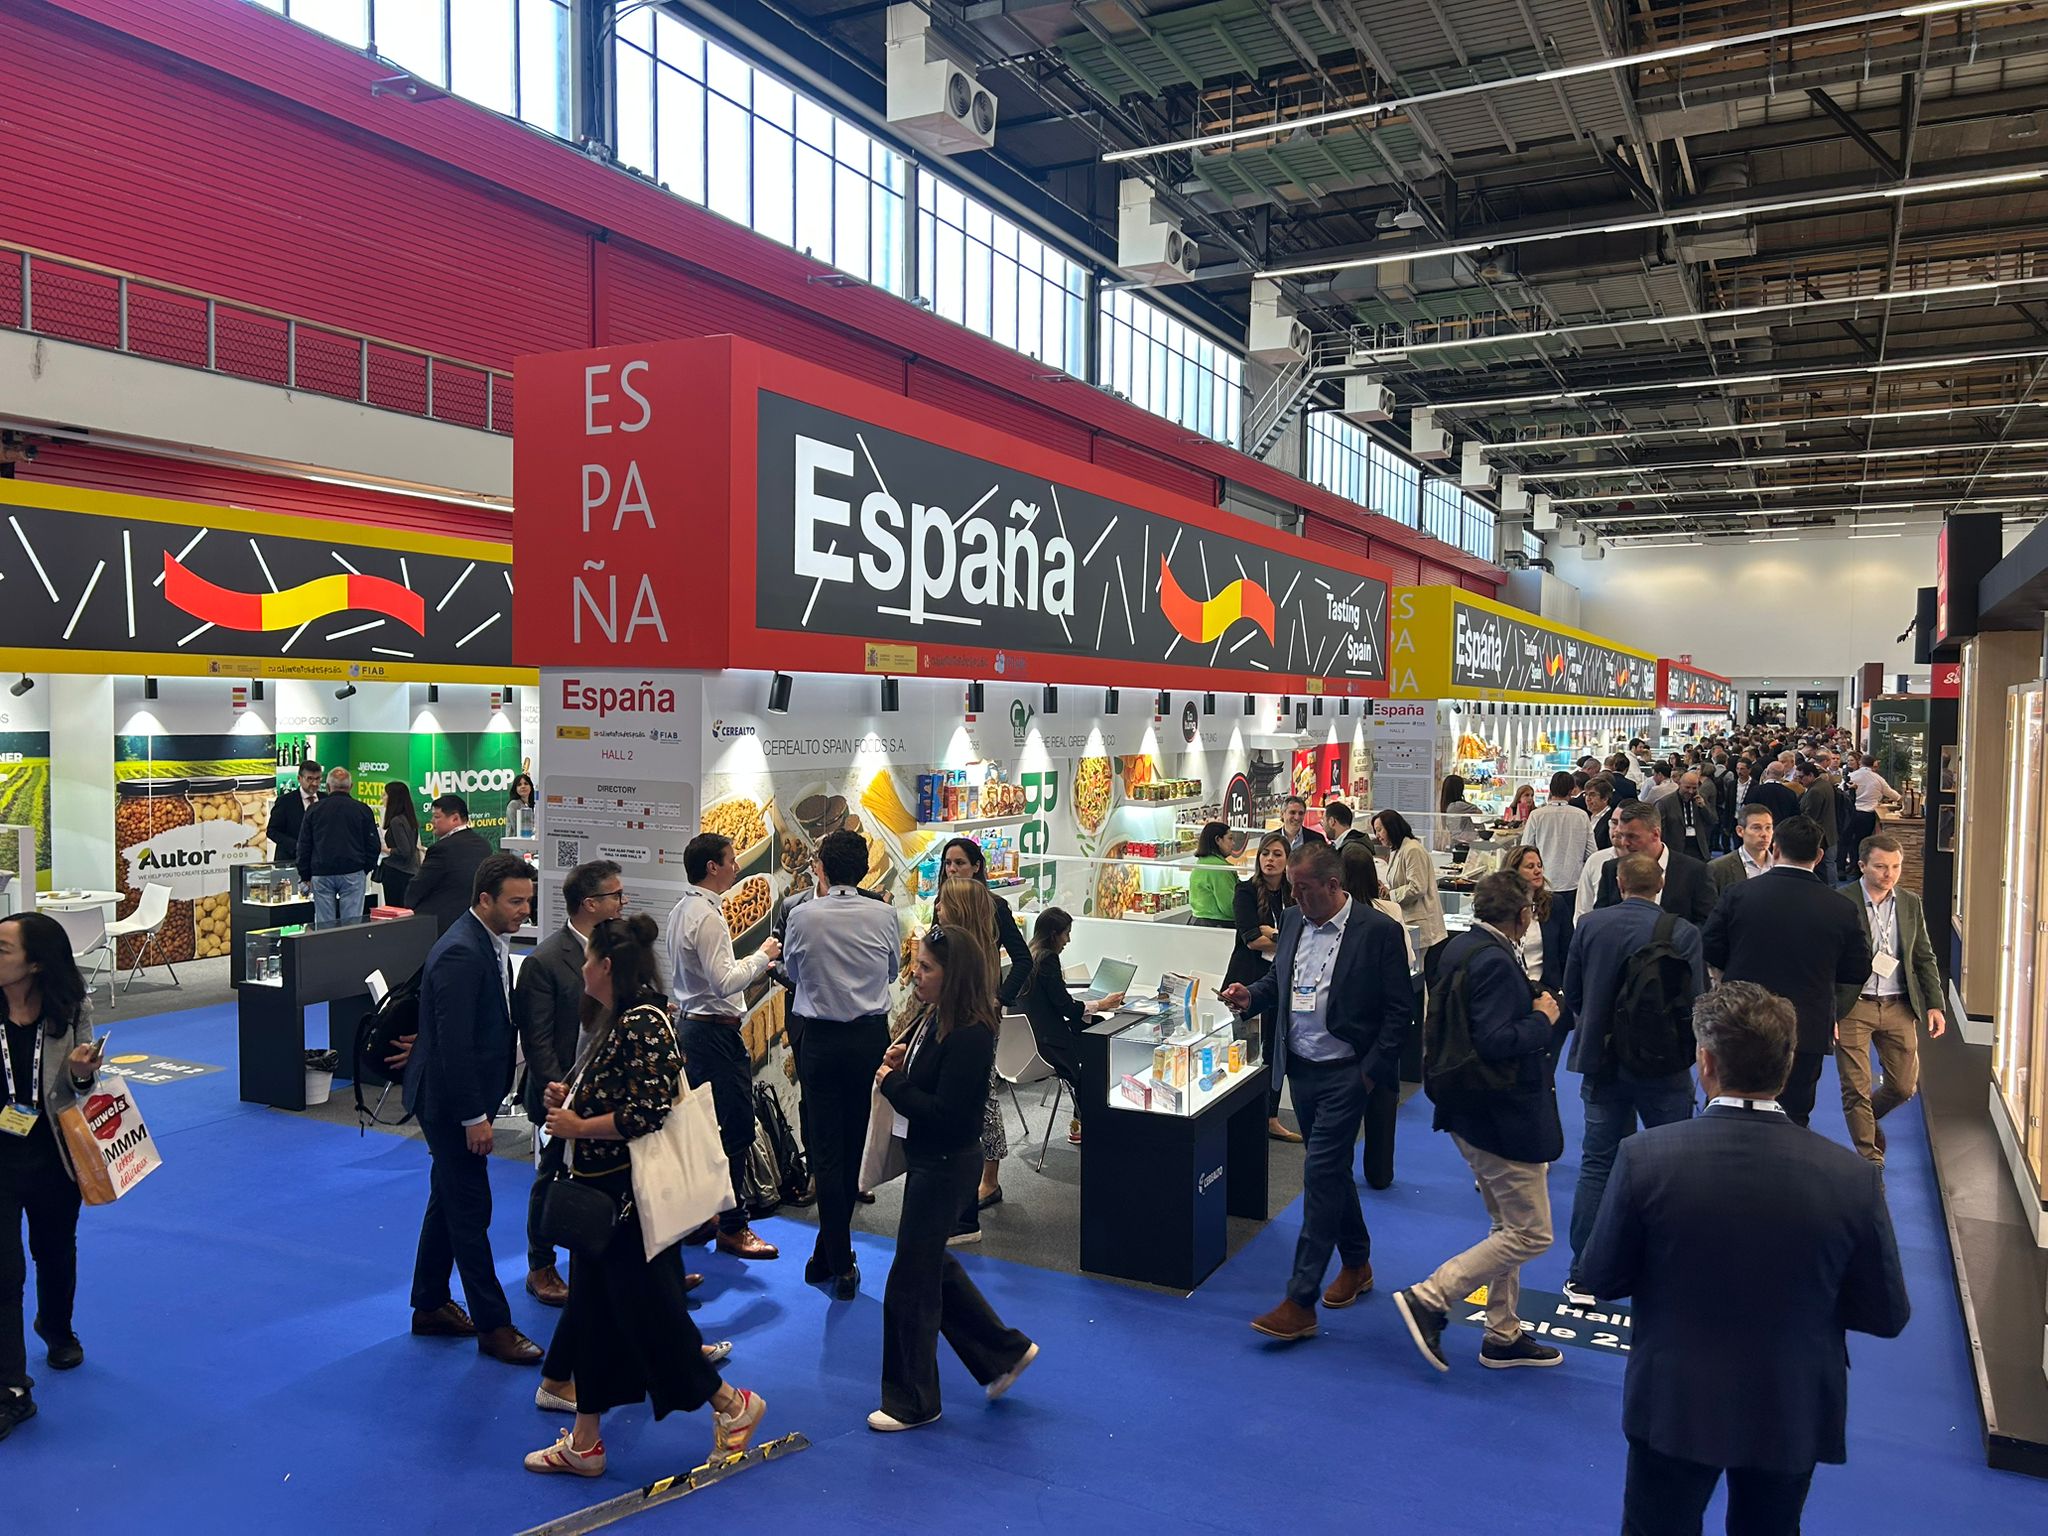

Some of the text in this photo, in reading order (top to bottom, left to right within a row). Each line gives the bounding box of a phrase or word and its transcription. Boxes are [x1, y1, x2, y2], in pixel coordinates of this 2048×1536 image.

[584, 360, 651, 435] ES
[582, 460, 656, 532] PA
[794, 433, 1075, 625] España
[573, 560, 668, 643] ÑA
[1326, 593, 1360, 630] Tasting
[1347, 634, 1372, 665] Spain
[1456, 613, 1502, 679] España
[362, 666, 385, 675] FIAB
[562, 679, 675, 718] España
[1374, 703, 1424, 718] España
[309, 716, 339, 726] GROUP
[660, 731, 678, 739] FIAB
[721, 727, 755, 736] CEREALTO
[1052, 735, 1066, 747] REAL
[601, 749, 633, 760] HALL 2
[763, 739, 820, 755] CEREALTO
[823, 738, 852, 754] SPAIN
[889, 738, 906, 752] S.A.
[358, 782, 385, 796] EXTR
[418, 768, 515, 800] JAENCOOP
[597, 785, 636, 794] DIRECTORY
[1232, 793, 1243, 812] Ta
[477, 818, 497, 827] OLIVE
[137, 848, 216, 870] Autor
[1466, 1310, 1577, 1339] Asle
[1555, 1303, 1631, 1328] Hall
